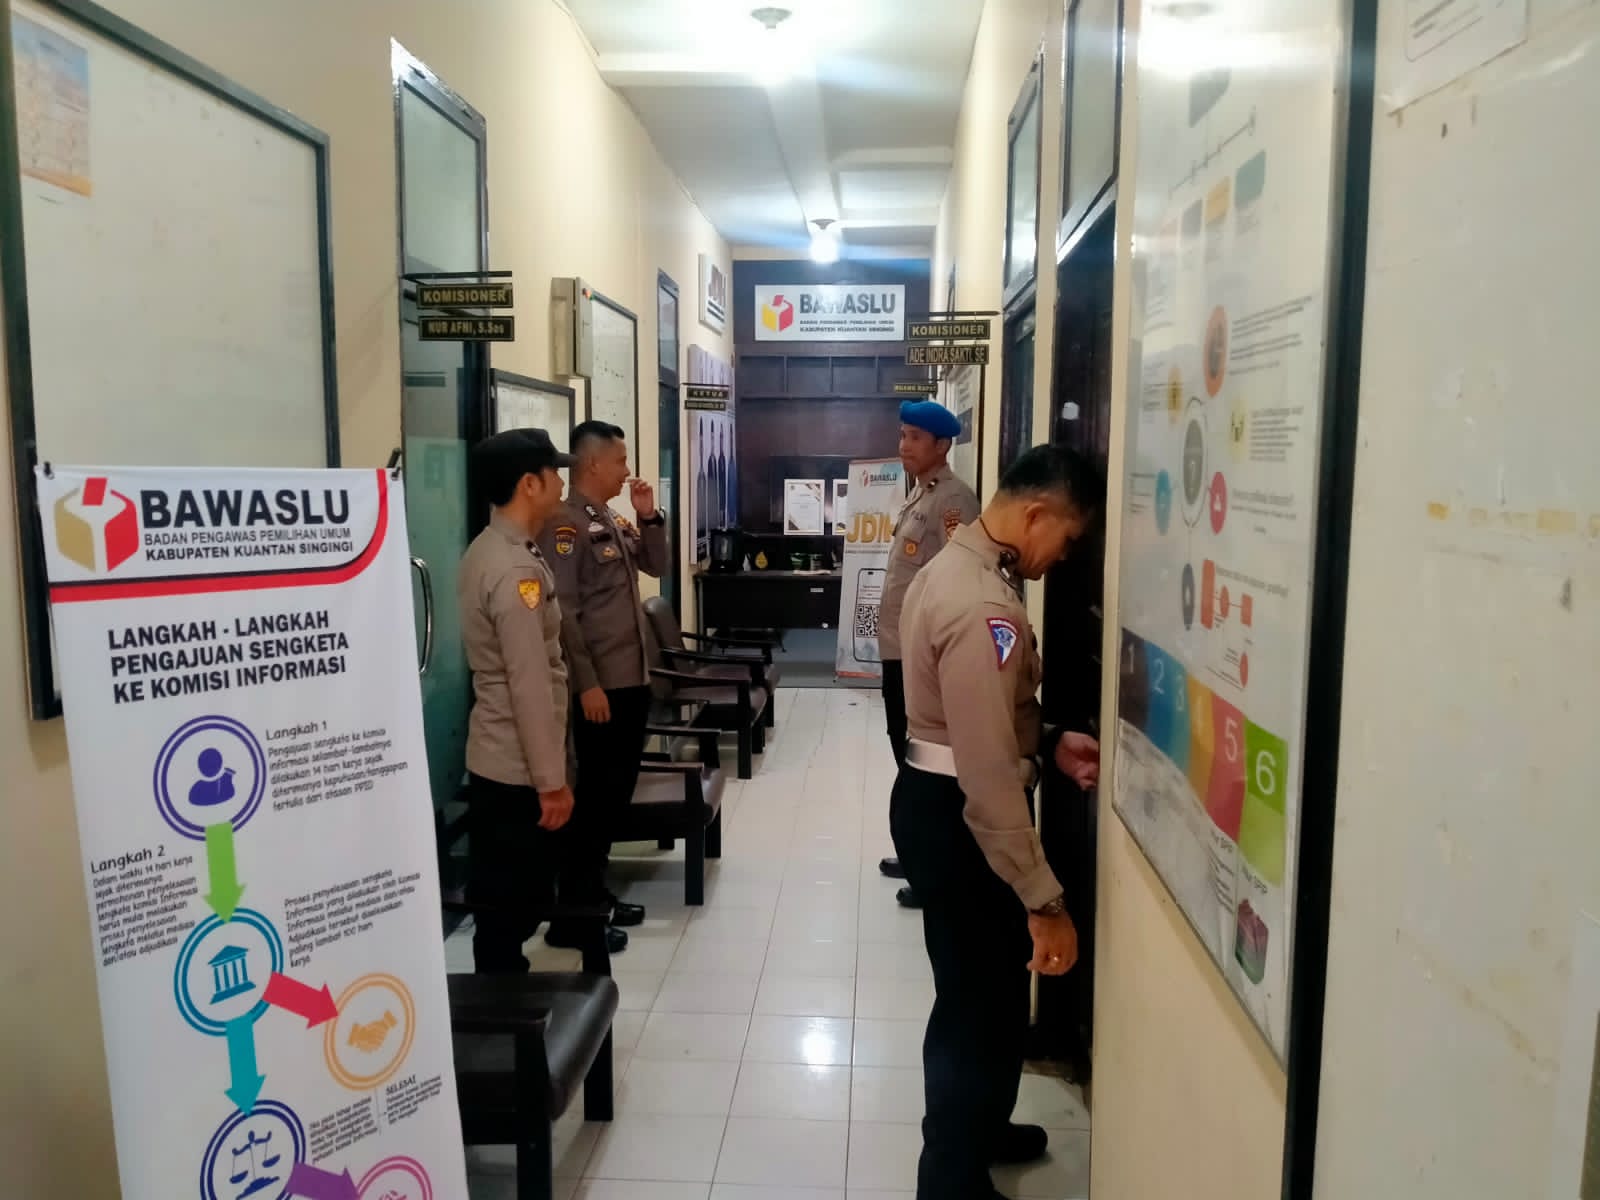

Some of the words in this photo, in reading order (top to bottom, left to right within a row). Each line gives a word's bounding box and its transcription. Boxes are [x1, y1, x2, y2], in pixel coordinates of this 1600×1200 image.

[424, 289, 506, 303] KOMISIONER
[912, 324, 985, 336] KOMISIONER
[910, 348, 925, 362] ADE
[926, 347, 948, 362] INDRA
[975, 346, 985, 362] SE
[139, 489, 350, 529] BAWASLU
[144, 532, 188, 546] BADAN
[191, 530, 257, 544] PENGAWAS
[260, 529, 318, 542] PEMILIHAN
[320, 527, 351, 540] UMUM
[145, 546, 230, 561] KABUPATEN
[233, 543, 296, 558] KUANTAN
[298, 541, 354, 555] SINGINGI
[108, 620, 217, 650] LANGKAH
[234, 610, 330, 638] LANGKAH
[110, 643, 244, 678] PENGAJUAN
[249, 632, 350, 661] SENGKETA
[113, 680, 144, 704] KE
[150, 670, 230, 700] KOMISI
[236, 654, 346, 686] INFORMASI
[1152, 658, 1165, 694] 2
[266, 722, 319, 741] Langkah
[322, 720, 328, 730] 1
[1224, 716, 1238, 763] 5
[1255, 750, 1276, 795] 6
[90, 848, 152, 874] Langkah
[158, 844, 166, 857] 2
